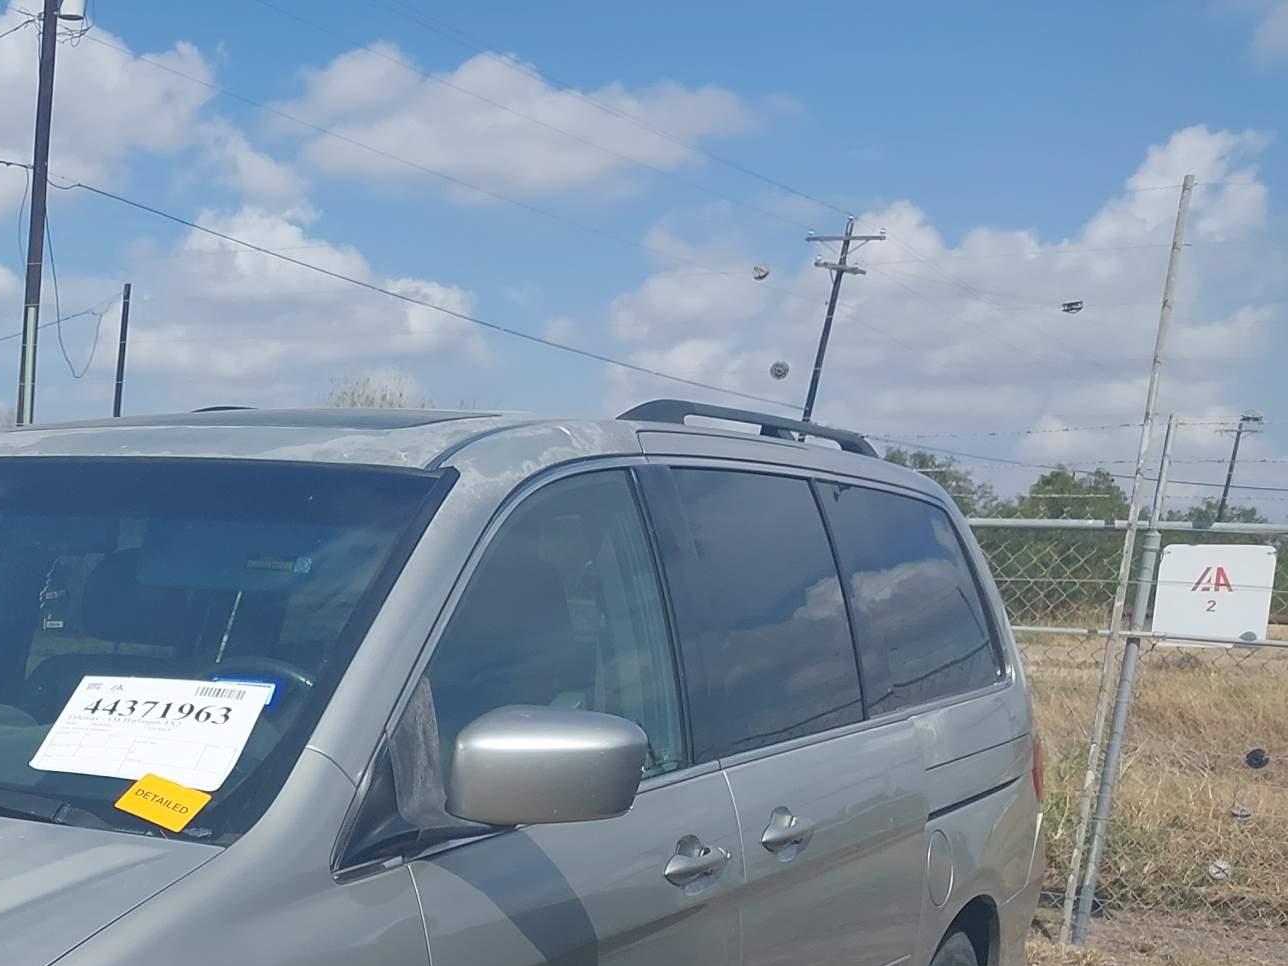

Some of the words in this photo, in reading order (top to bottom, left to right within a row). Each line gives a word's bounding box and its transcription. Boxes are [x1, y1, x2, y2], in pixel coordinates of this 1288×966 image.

[1206, 600, 1216, 612] 2
[83, 698, 233, 725] 44371963
[134, 788, 189, 815] DETAILED
